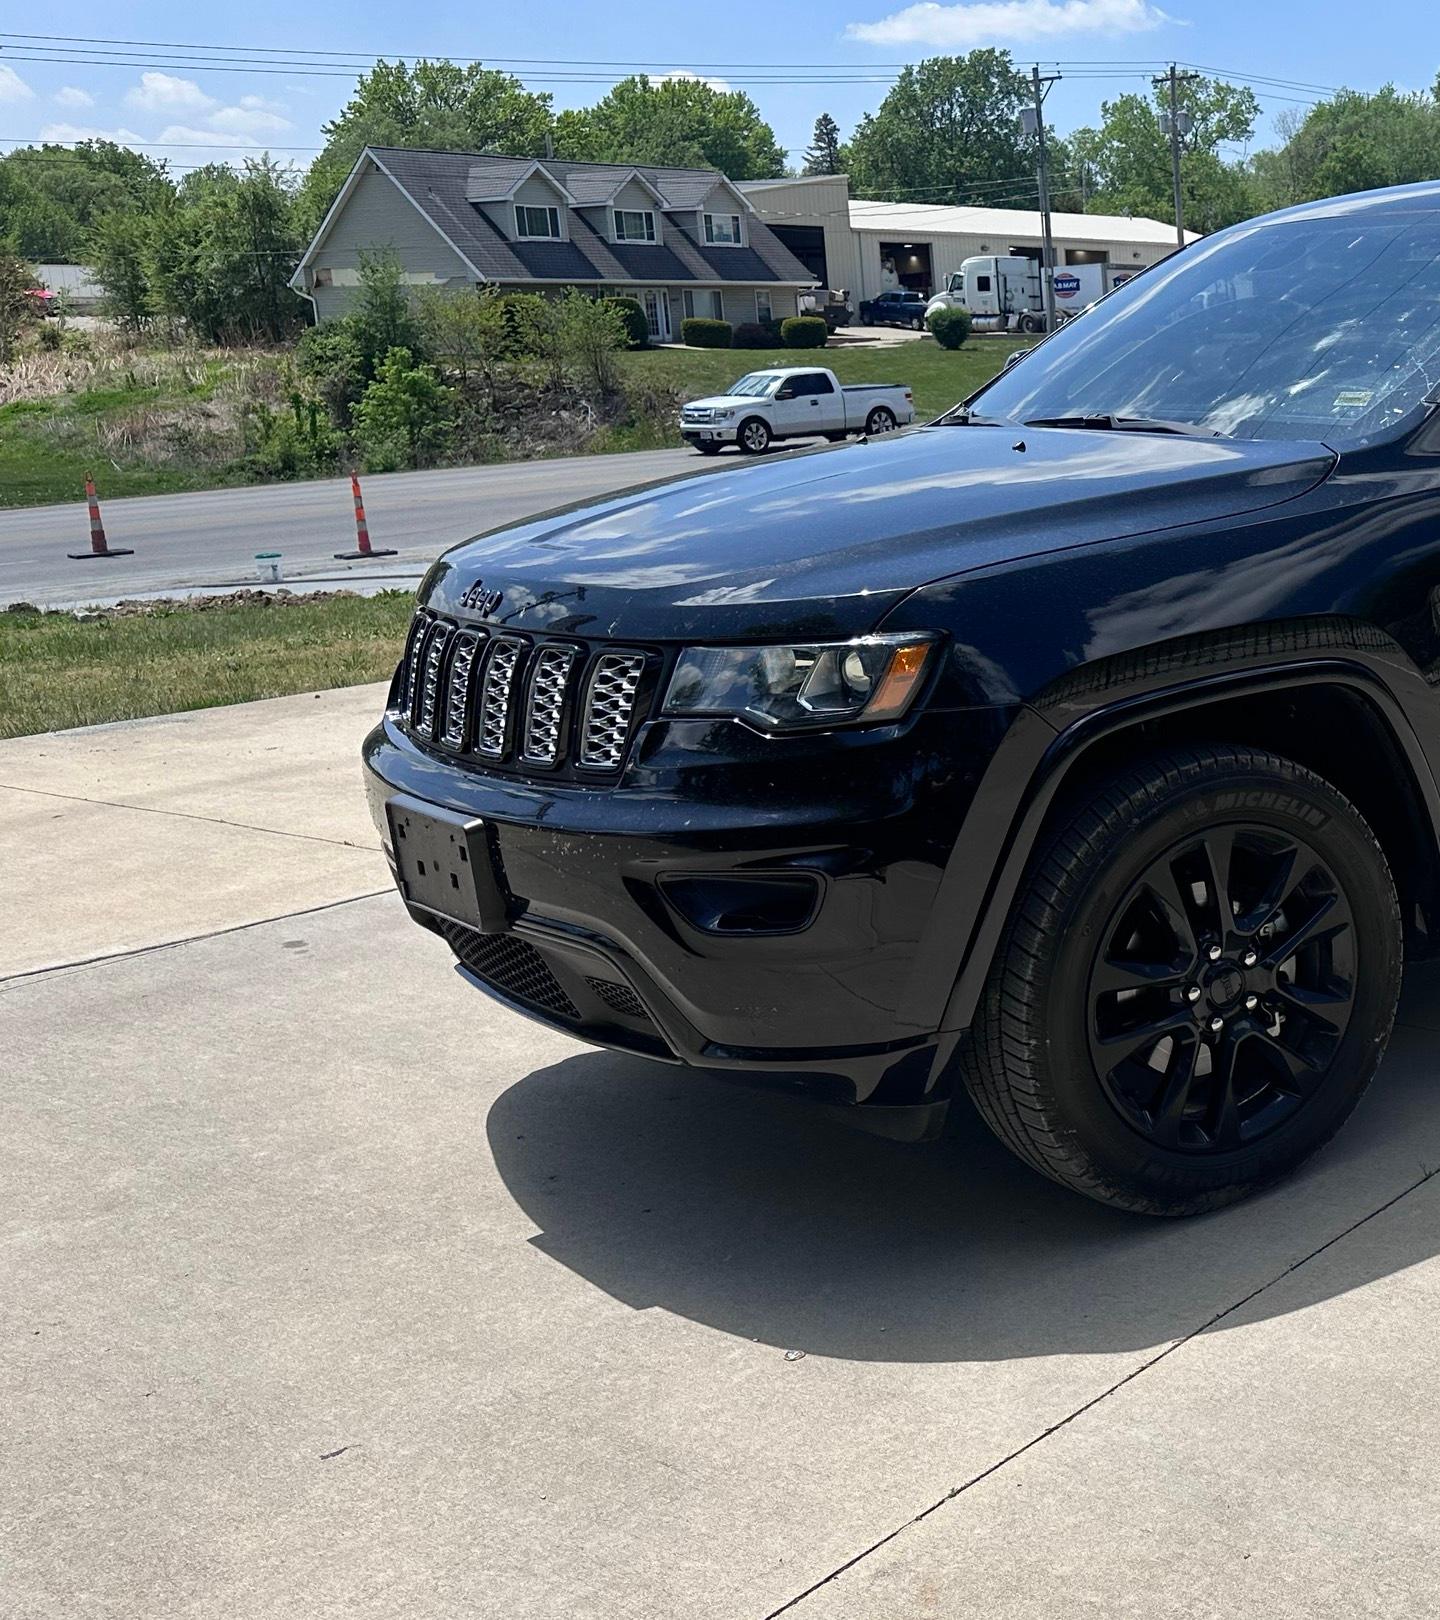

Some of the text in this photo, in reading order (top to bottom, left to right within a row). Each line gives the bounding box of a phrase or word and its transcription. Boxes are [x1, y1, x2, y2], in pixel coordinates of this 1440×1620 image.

[1063, 281, 1078, 289] MAY
[459, 578, 504, 618] Jeep
[1215, 791, 1327, 826] MICHELIN
